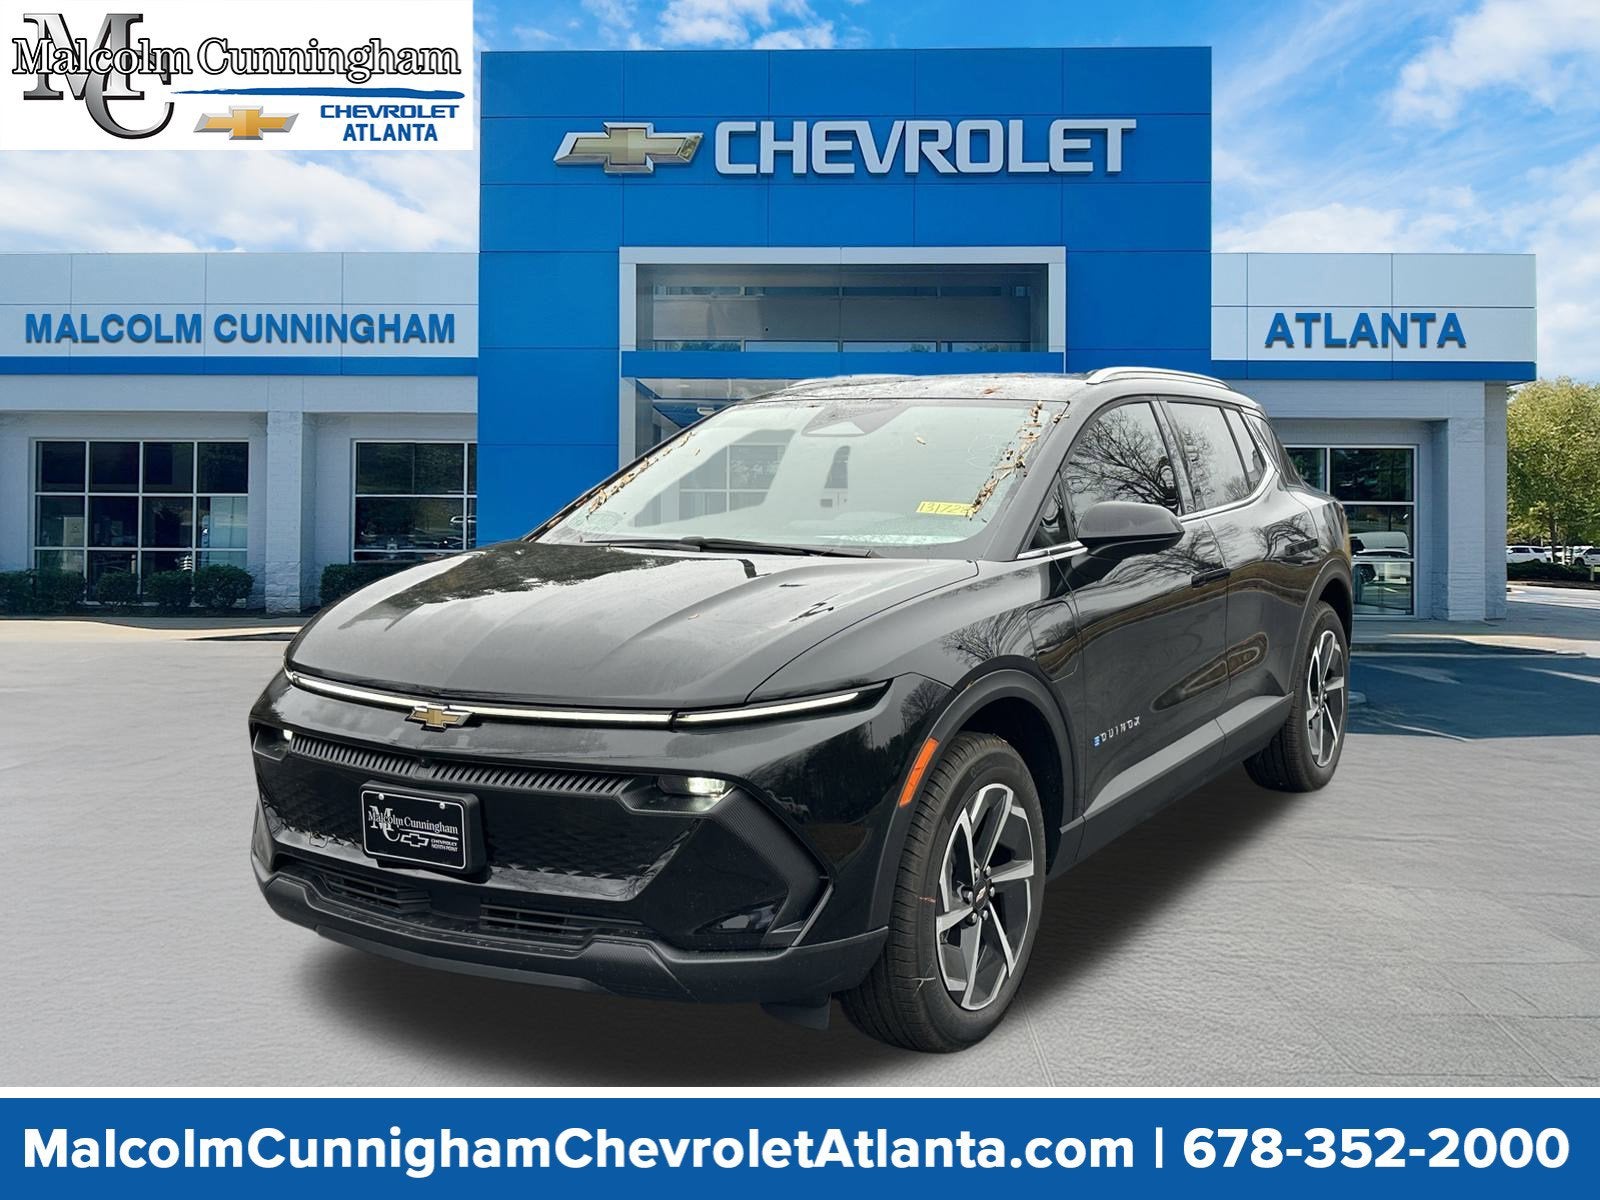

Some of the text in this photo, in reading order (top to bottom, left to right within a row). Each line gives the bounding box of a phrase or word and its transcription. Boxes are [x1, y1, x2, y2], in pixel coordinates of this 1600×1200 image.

[714, 118, 1137, 174] CHEVROLET
[25, 313, 456, 343] MALCOLM CUNNINGHAM
[1264, 312, 1467, 348] ATLANTA
[368, 810, 458, 834] Malcolm Cunningham
